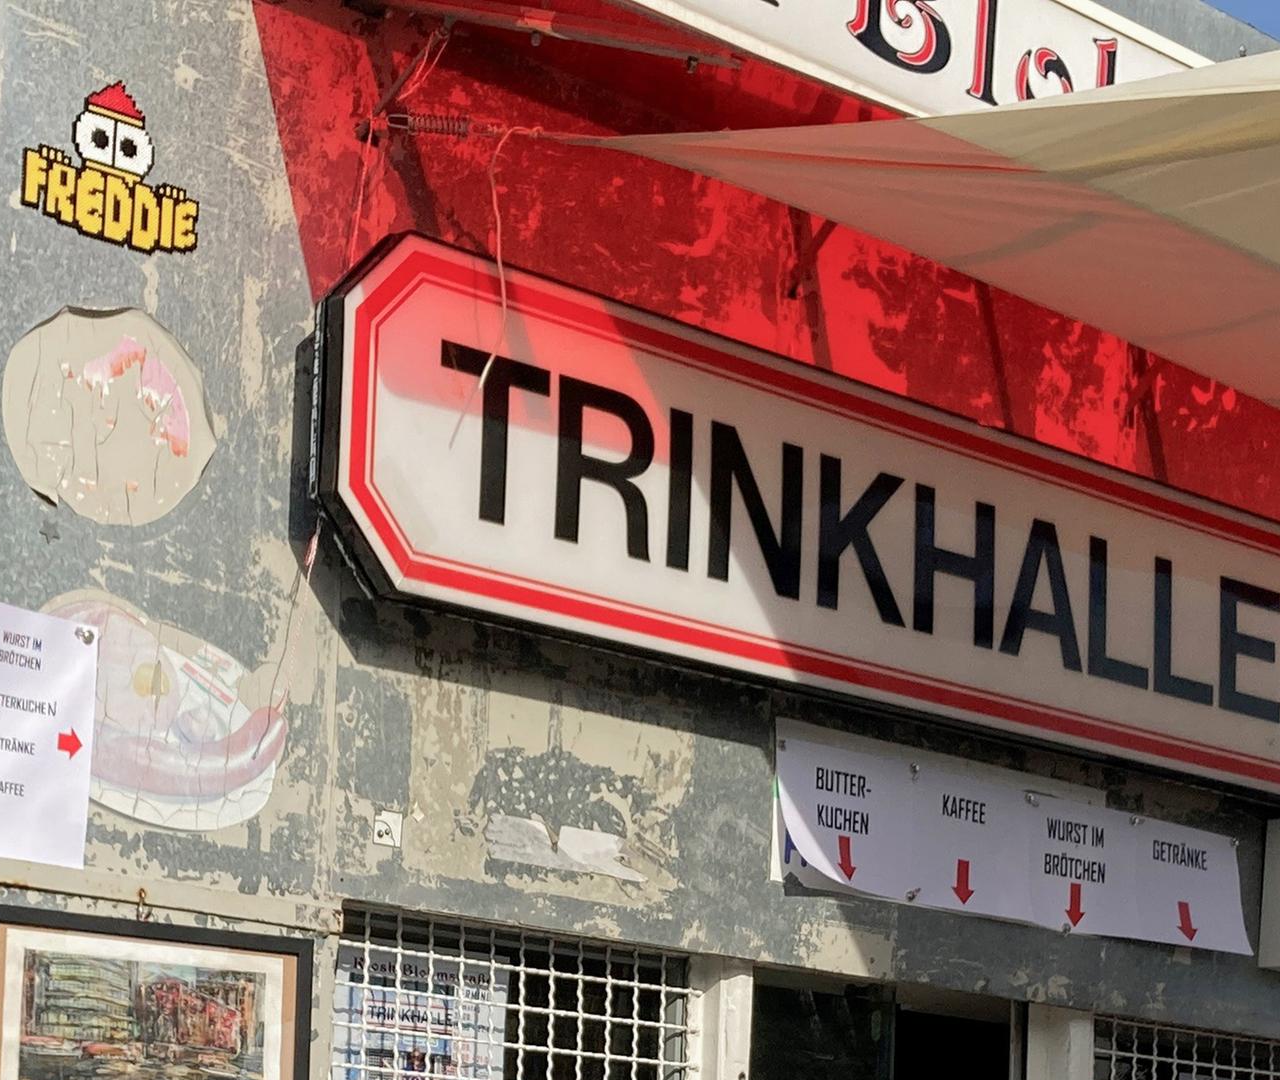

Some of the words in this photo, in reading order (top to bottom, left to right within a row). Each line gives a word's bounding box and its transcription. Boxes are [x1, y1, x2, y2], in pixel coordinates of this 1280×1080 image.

[23, 148, 199, 255] FREDDIE
[2, 629, 30, 650] WURST
[31, 639, 42, 651] IM
[815, 766, 872, 799] BUTTER-
[816, 803, 869, 836] KUCHEN
[942, 794, 987, 825] KAFFEE
[1046, 817, 1087, 846] WURST
[1090, 826, 1105, 849] IM
[1043, 852, 1107, 884] BRÖTCHEN
[1152, 839, 1207, 871] GETRÄNKE
